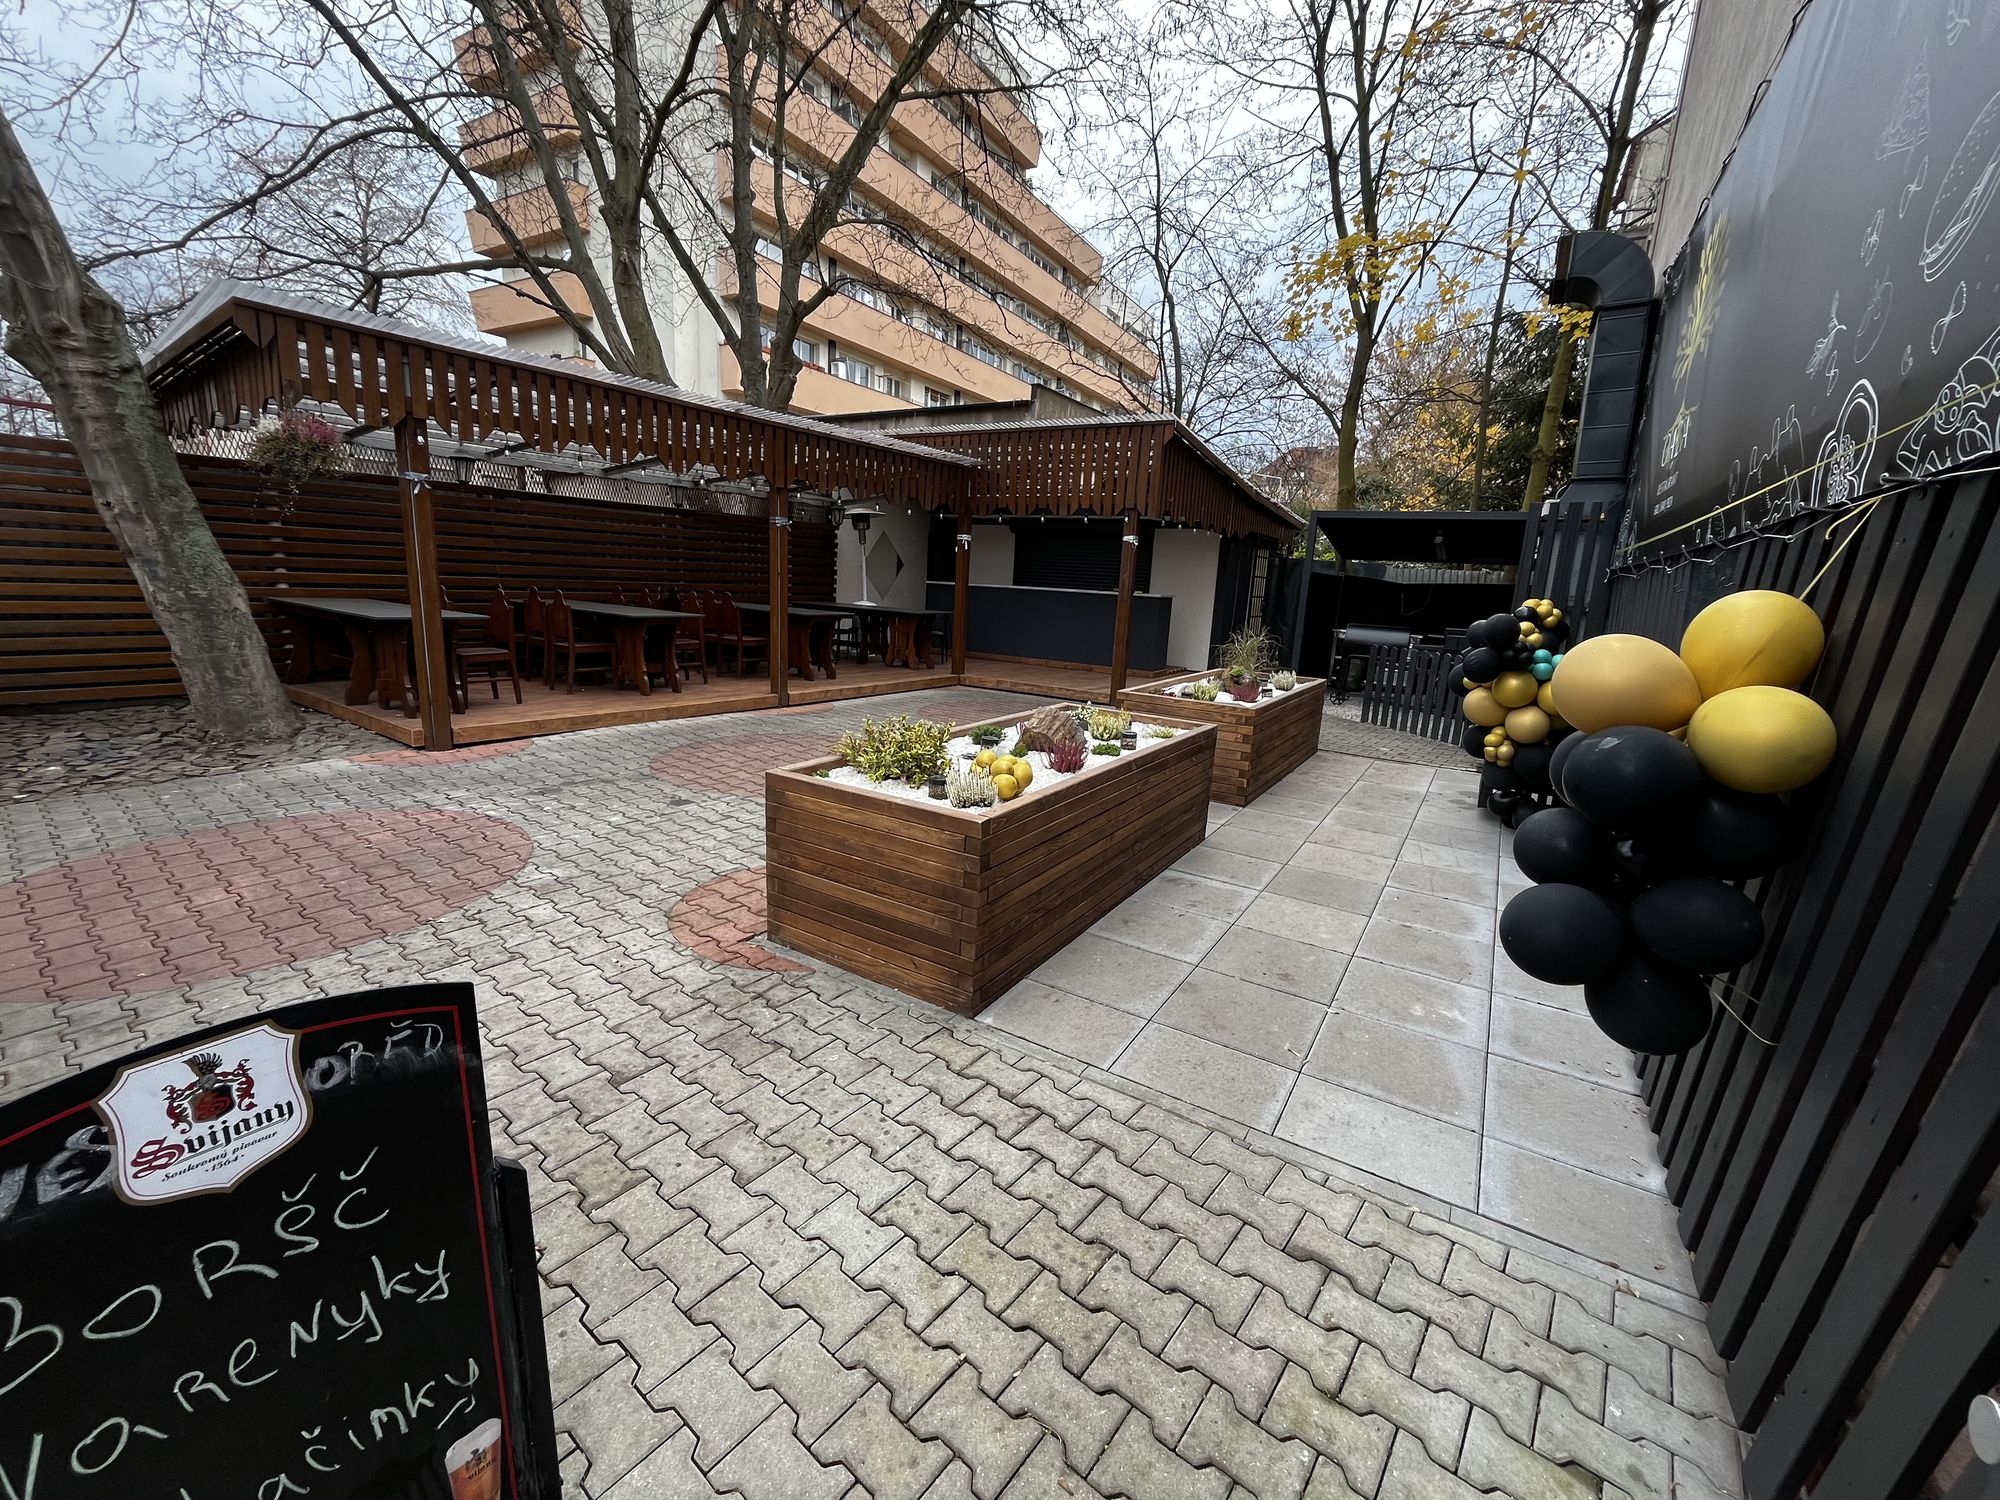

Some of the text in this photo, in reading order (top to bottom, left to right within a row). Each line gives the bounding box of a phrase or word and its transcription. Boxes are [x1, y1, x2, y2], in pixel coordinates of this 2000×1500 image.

[130, 1100, 294, 1180] Svijany
[161, 1131, 278, 1182] Soukromý pivovar
